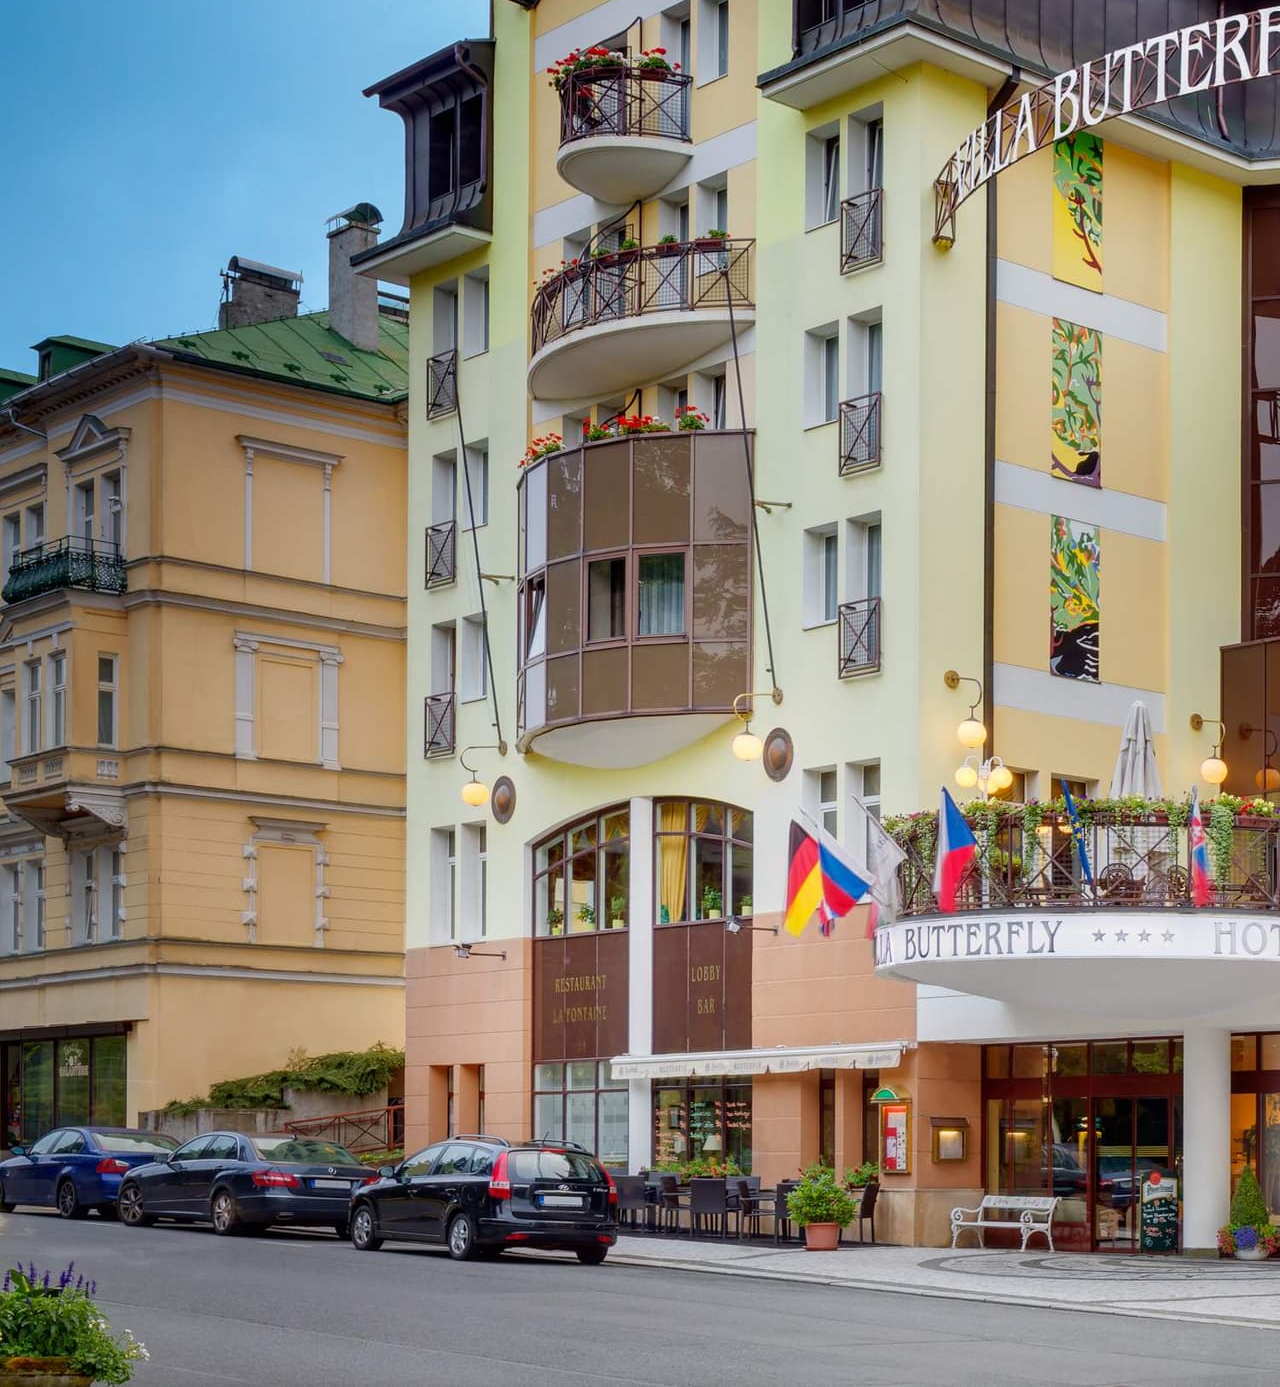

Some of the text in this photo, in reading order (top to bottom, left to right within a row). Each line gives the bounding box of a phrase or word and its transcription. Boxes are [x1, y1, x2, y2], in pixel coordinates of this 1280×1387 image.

[954, 92, 1037, 202] VILLA
[904, 920, 1063, 960] BUTTERFLY
[691, 964, 721, 982] LOBBY
[555, 974, 608, 993] RESTAURANT
[697, 998, 715, 1014] BAR
